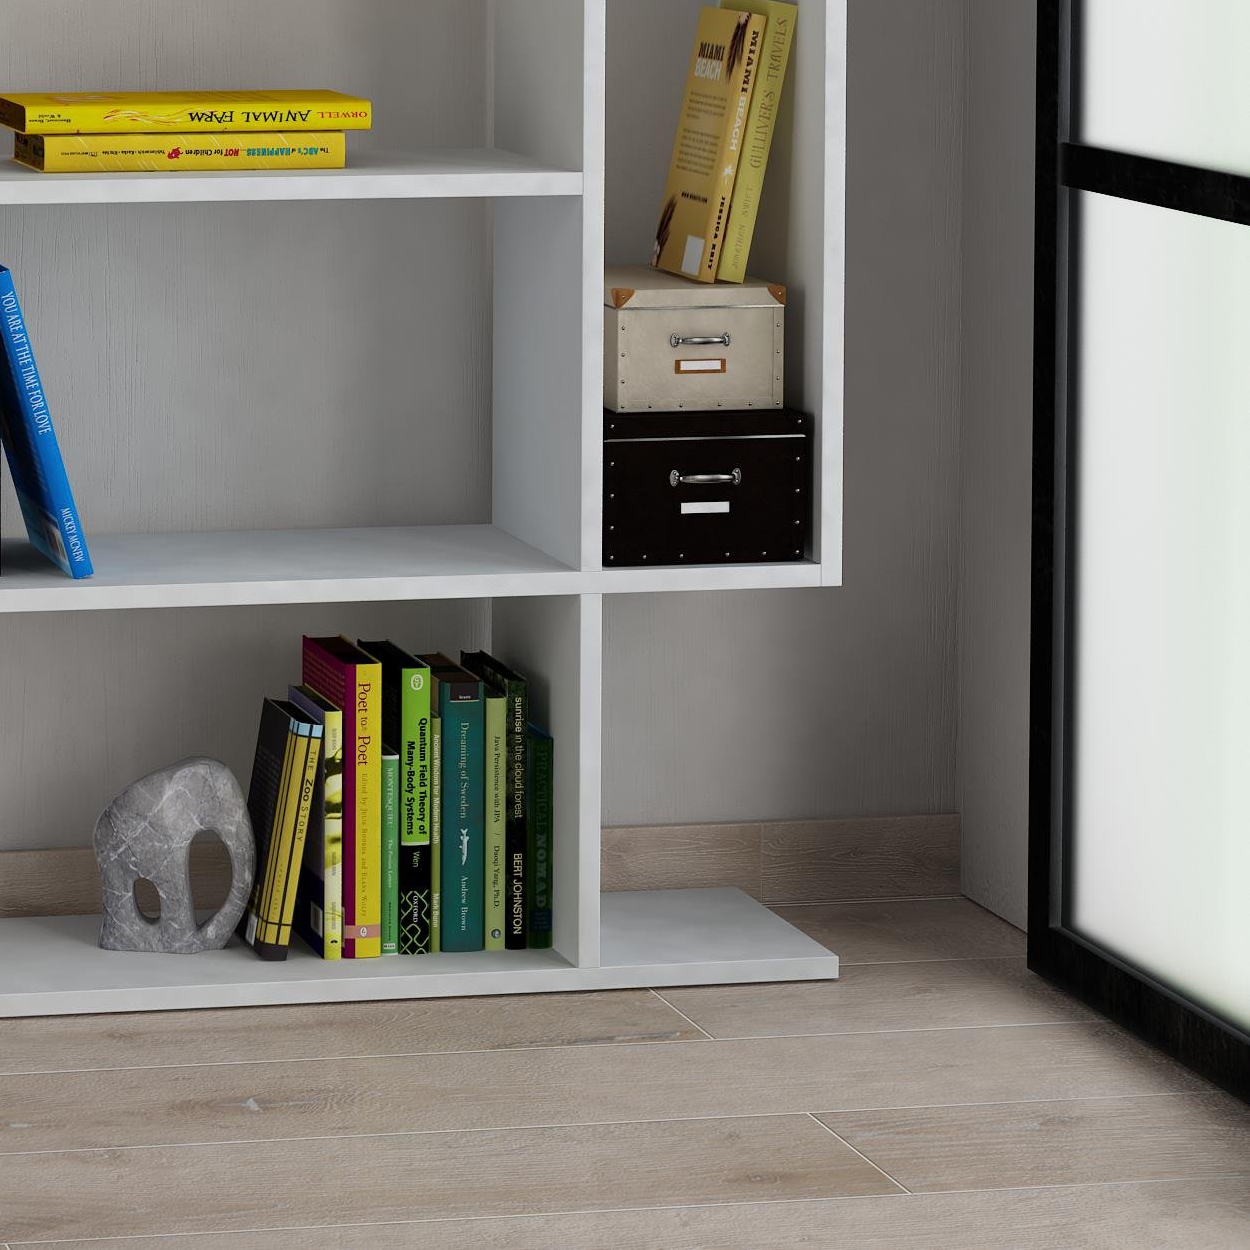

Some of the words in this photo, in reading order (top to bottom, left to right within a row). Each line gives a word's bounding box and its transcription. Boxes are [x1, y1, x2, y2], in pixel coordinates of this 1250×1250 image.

[741, 30, 759, 93] MIAMI
[766, 17, 788, 81] TRAVELS
[187, 111, 235, 123] FARM
[242, 110, 311, 123] ANIMAL
[318, 111, 368, 119] ORWELL
[730, 95, 747, 151] BEACH
[714, 196, 725, 239] JESSICA
[1, 291, 17, 312] YOU
[7, 315, 23, 331] ARE
[11, 333, 27, 344] AT
[16, 344, 32, 365] THE
[22, 365, 38, 390] TIME
[28, 389, 44, 410] FOR
[33, 408, 50, 435] LOVE
[61, 507, 77, 535] MICKEY
[69, 535, 85, 562] MCNEW
[358, 683, 371, 713] Poet
[361, 717, 368, 726] to
[515, 696, 524, 732] sunrise
[358, 735, 371, 766] Poet
[419, 718, 427, 761] Quantum
[458, 722, 469, 768] Dreaming
[515, 735, 524, 743] in
[308, 751, 317, 771] THE
[515, 746, 524, 760] the
[405, 741, 415, 794] Many-Body
[461, 770, 469, 780] of
[515, 763, 524, 788] cloud
[359, 797, 369, 806] by
[461, 781, 469, 818] Sweden
[515, 790, 524, 818] forest
[536, 751, 548, 831] PRACTICAL
[405, 797, 415, 835] Systems
[417, 790, 427, 822] Theory
[420, 825, 427, 835] of
[513, 853, 522, 877] BERT
[536, 833, 547, 909] NOMAD
[513, 879, 523, 935] JOHNSTON
